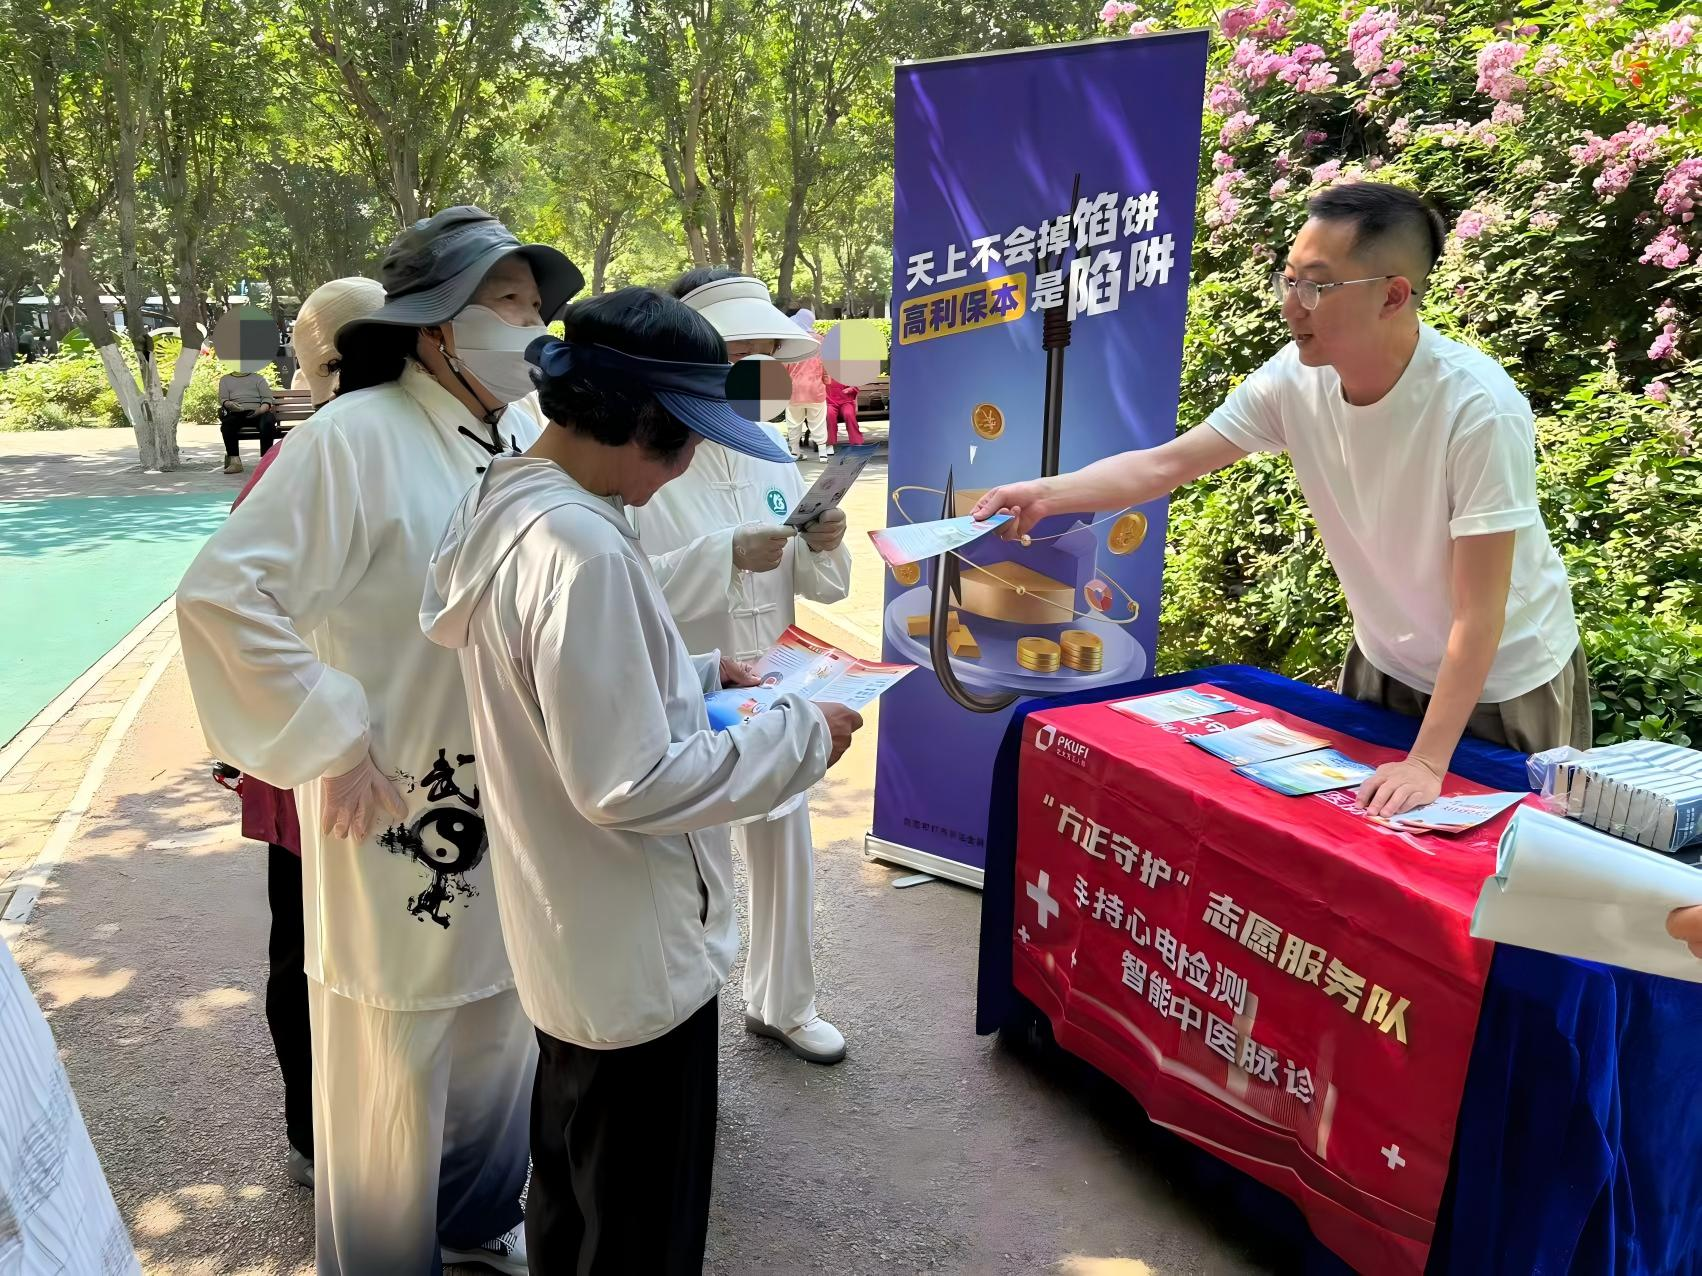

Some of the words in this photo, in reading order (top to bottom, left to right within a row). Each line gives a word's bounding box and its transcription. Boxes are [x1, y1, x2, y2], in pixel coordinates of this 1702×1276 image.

[903, 282, 1020, 339] 高利保本
[1030, 234, 1175, 321] 是陷阱
[906, 190, 1159, 291] 天上不会掉馅饼
[1057, 736, 1089, 759] PKUFI
[1073, 873, 1249, 1016] 手持心电检测
[1202, 890, 1413, 1045] 志愿服务队
[1121, 950, 1315, 1104] 智能中医脉诊
